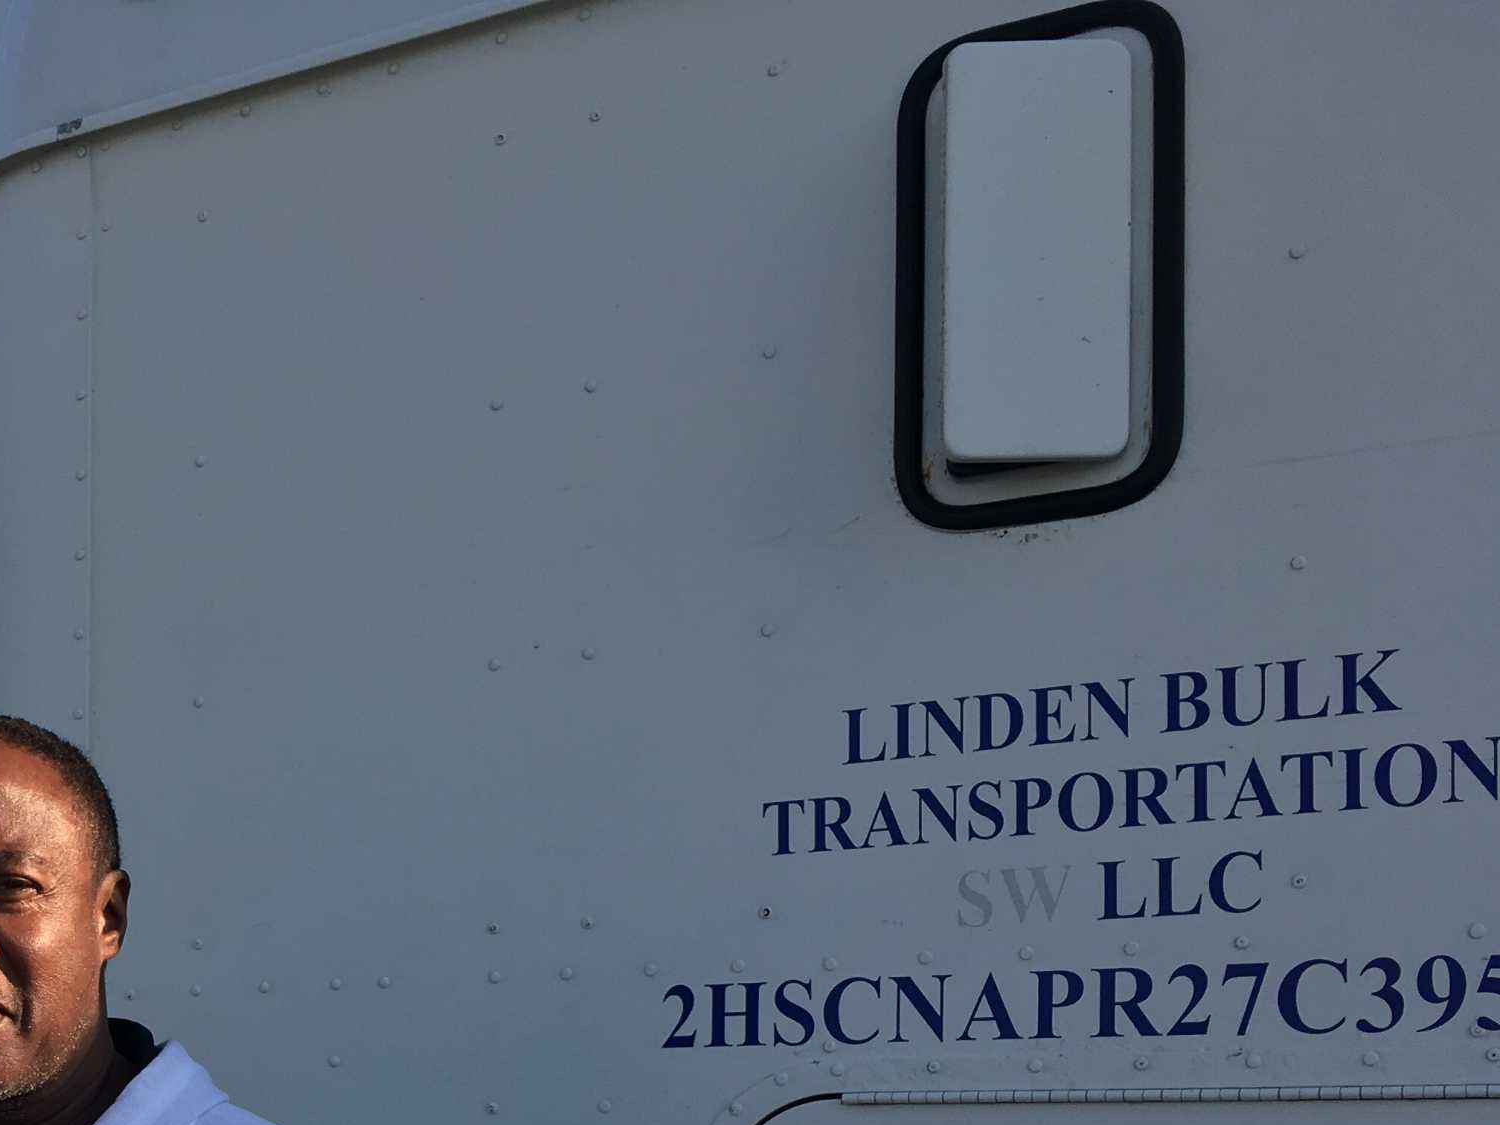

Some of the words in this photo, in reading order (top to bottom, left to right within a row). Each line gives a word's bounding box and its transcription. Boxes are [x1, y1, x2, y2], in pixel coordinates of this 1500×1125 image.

[841, 677, 1136, 766] LINDEN
[1159, 648, 1403, 734] BULK
[762, 736, 1500, 857] TRANSPORTATION
[956, 865, 1073, 929] SW
[1097, 849, 1265, 921] LLC
